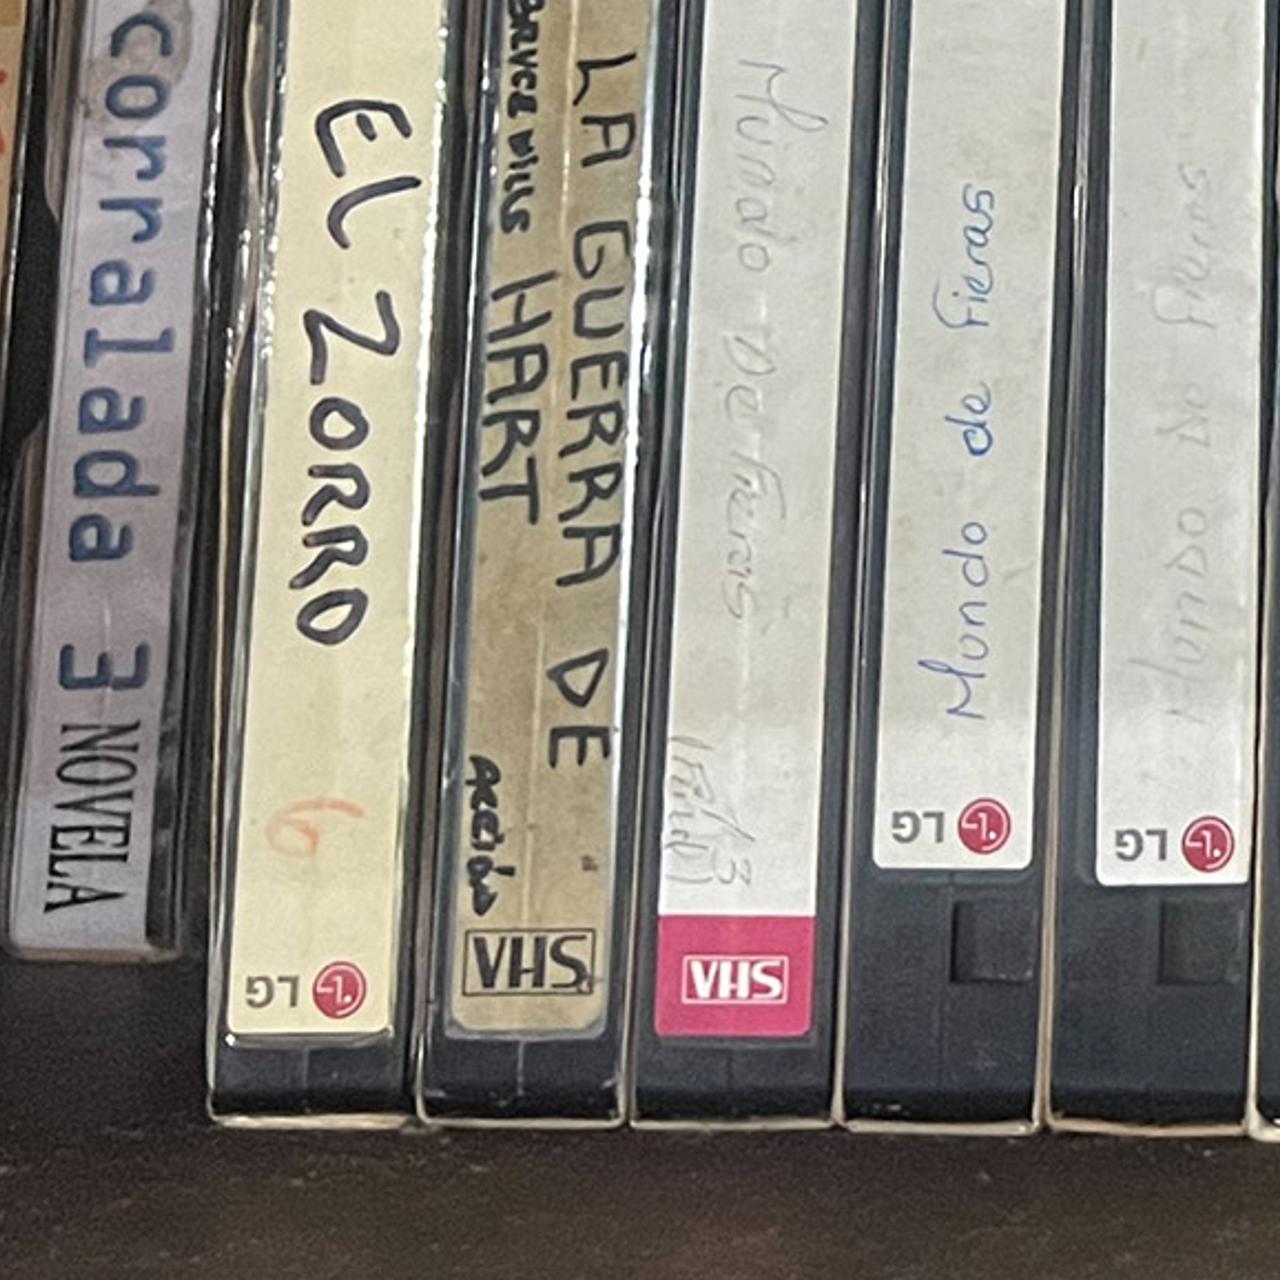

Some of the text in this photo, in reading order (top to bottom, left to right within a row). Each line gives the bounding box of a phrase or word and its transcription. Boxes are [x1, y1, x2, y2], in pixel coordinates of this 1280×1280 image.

[290, 290, 401, 646] ZORRO
[479, 270, 561, 525] HART
[546, 52, 639, 769] LA GUERRA DE
[43, 719, 142, 916] NOVELA
[1114, 828, 1168, 862] LG
[471, 934, 590, 991] VHS
[688, 958, 786, 1000] VHS
